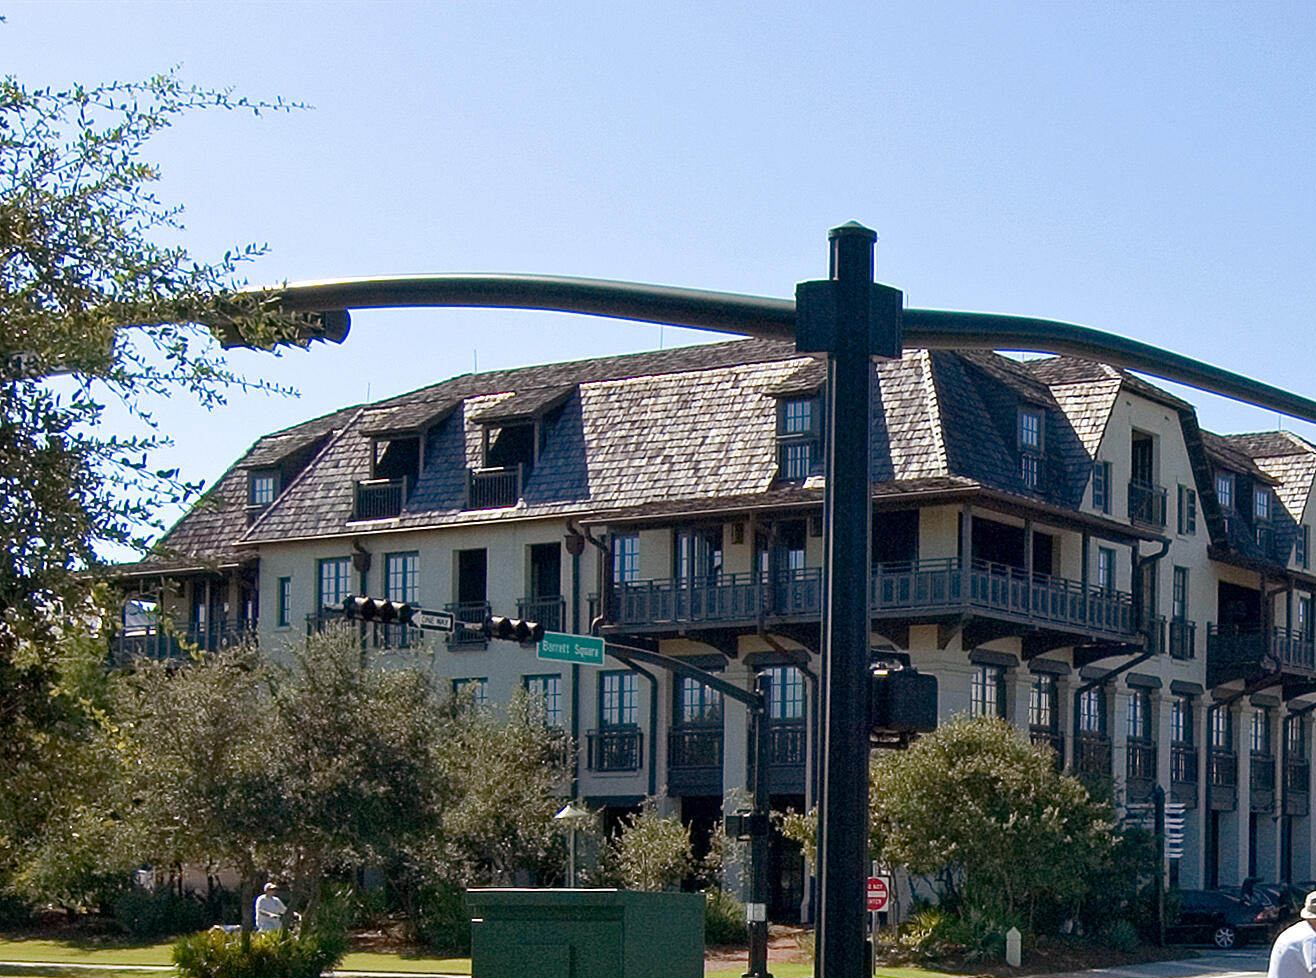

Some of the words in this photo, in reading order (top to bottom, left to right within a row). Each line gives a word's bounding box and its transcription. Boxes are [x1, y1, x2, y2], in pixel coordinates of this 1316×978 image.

[421, 615, 434, 624] ONE
[436, 617, 449, 626] WAY
[543, 639, 570, 654] Barrett
[574, 643, 599, 658] Square
